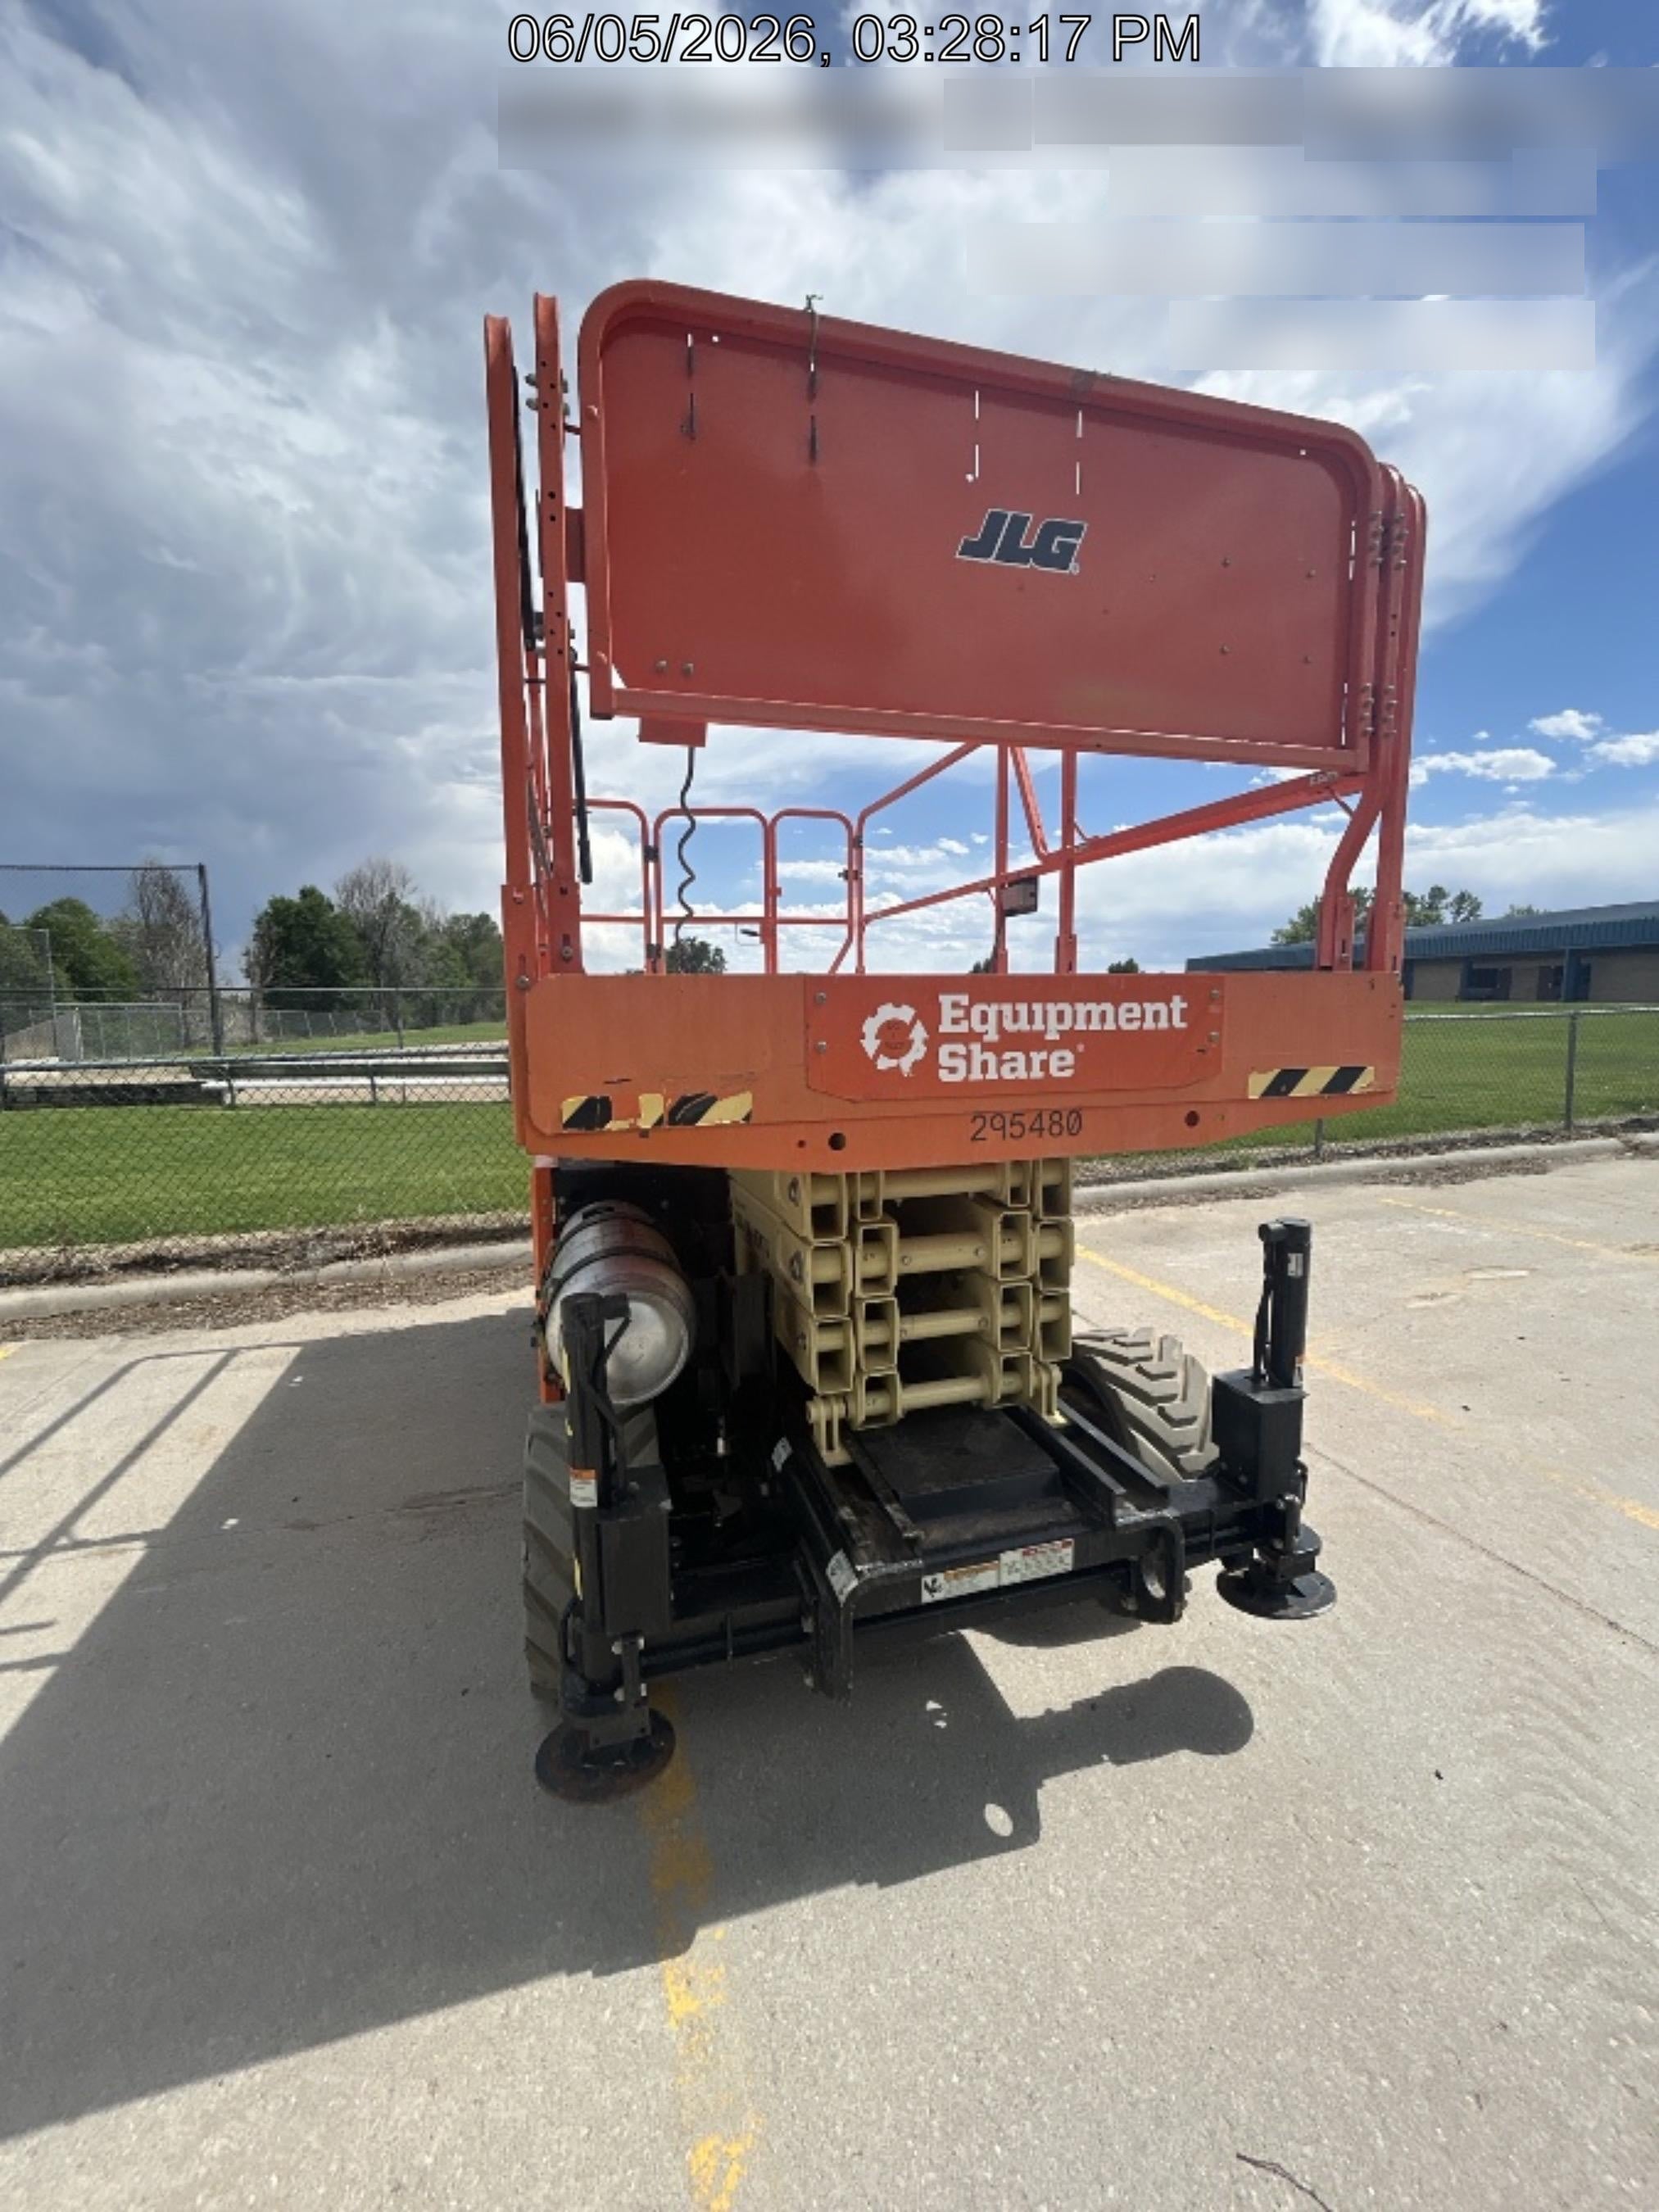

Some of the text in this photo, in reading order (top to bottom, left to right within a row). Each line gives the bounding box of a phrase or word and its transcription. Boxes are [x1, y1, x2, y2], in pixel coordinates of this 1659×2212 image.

[955, 508, 1088, 573] JLG
[937, 993, 1187, 1042] Equipment
[937, 1041, 1076, 1083] Share
[969, 1108, 1084, 1143] 295480
